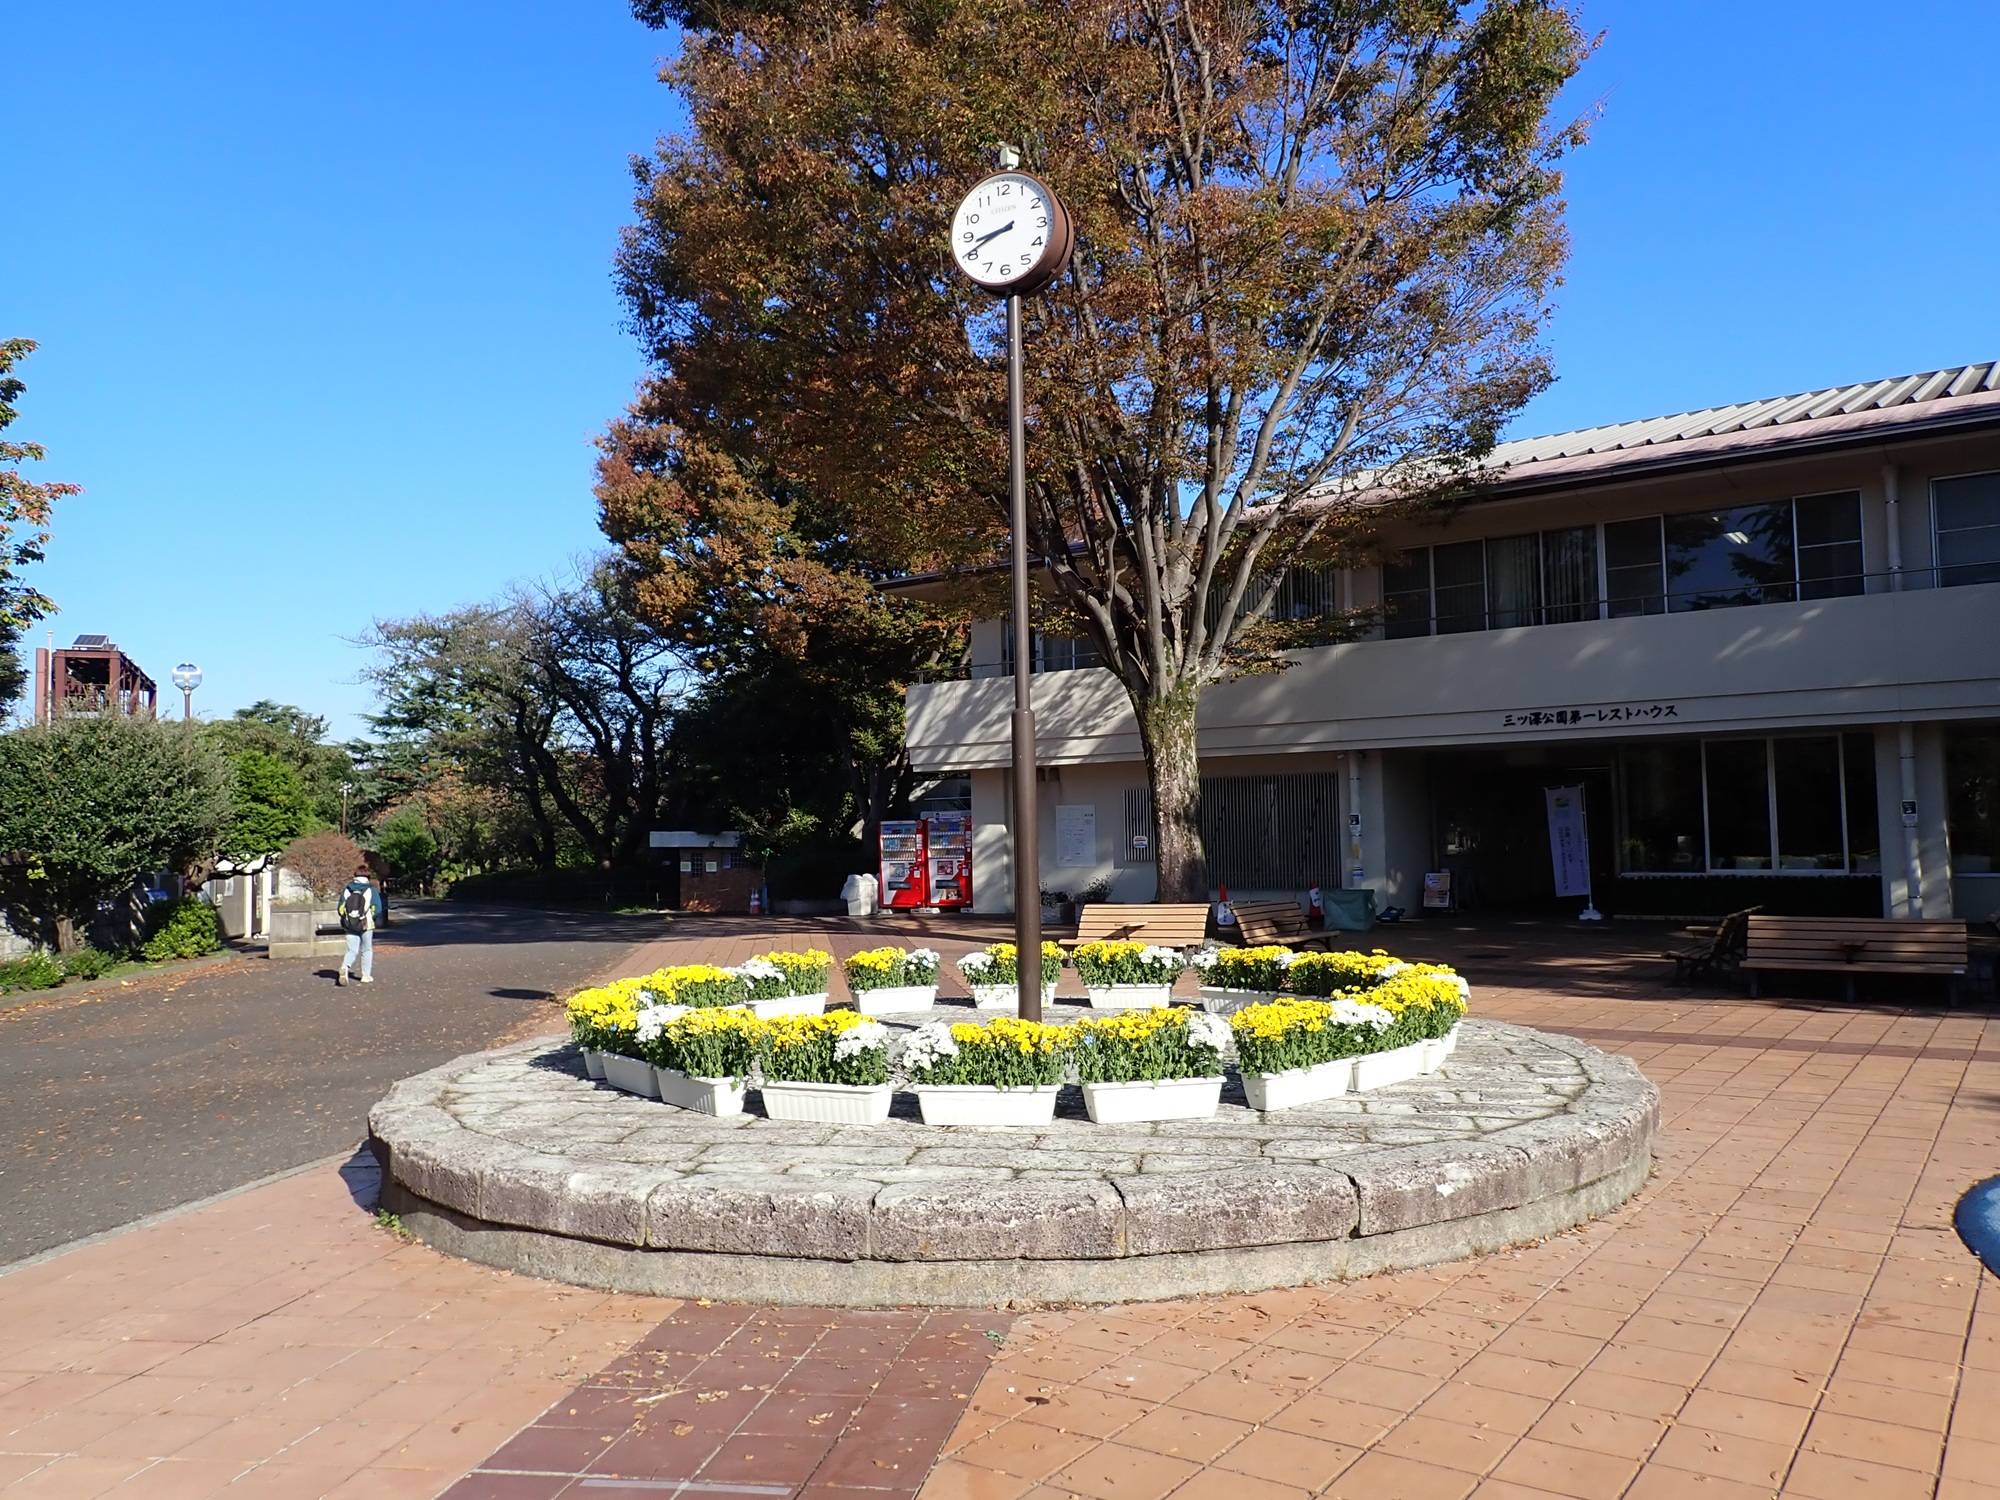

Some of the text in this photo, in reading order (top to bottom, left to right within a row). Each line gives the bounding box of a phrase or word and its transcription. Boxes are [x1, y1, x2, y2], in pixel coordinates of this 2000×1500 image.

[996, 184, 1010, 197] 12
[1020, 185, 1024, 196] 1
[979, 195, 990, 208] 11
[1031, 198, 1041, 209] 2
[966, 213, 980, 225] 10
[1036, 217, 1048, 228] 3
[963, 232, 974, 243] 9
[1031, 236, 1043, 246] 4
[967, 249, 979, 261] 8
[1020, 254, 1031, 265] 5
[982, 262, 993, 273] 7
[1000, 264, 1011, 275] 6
